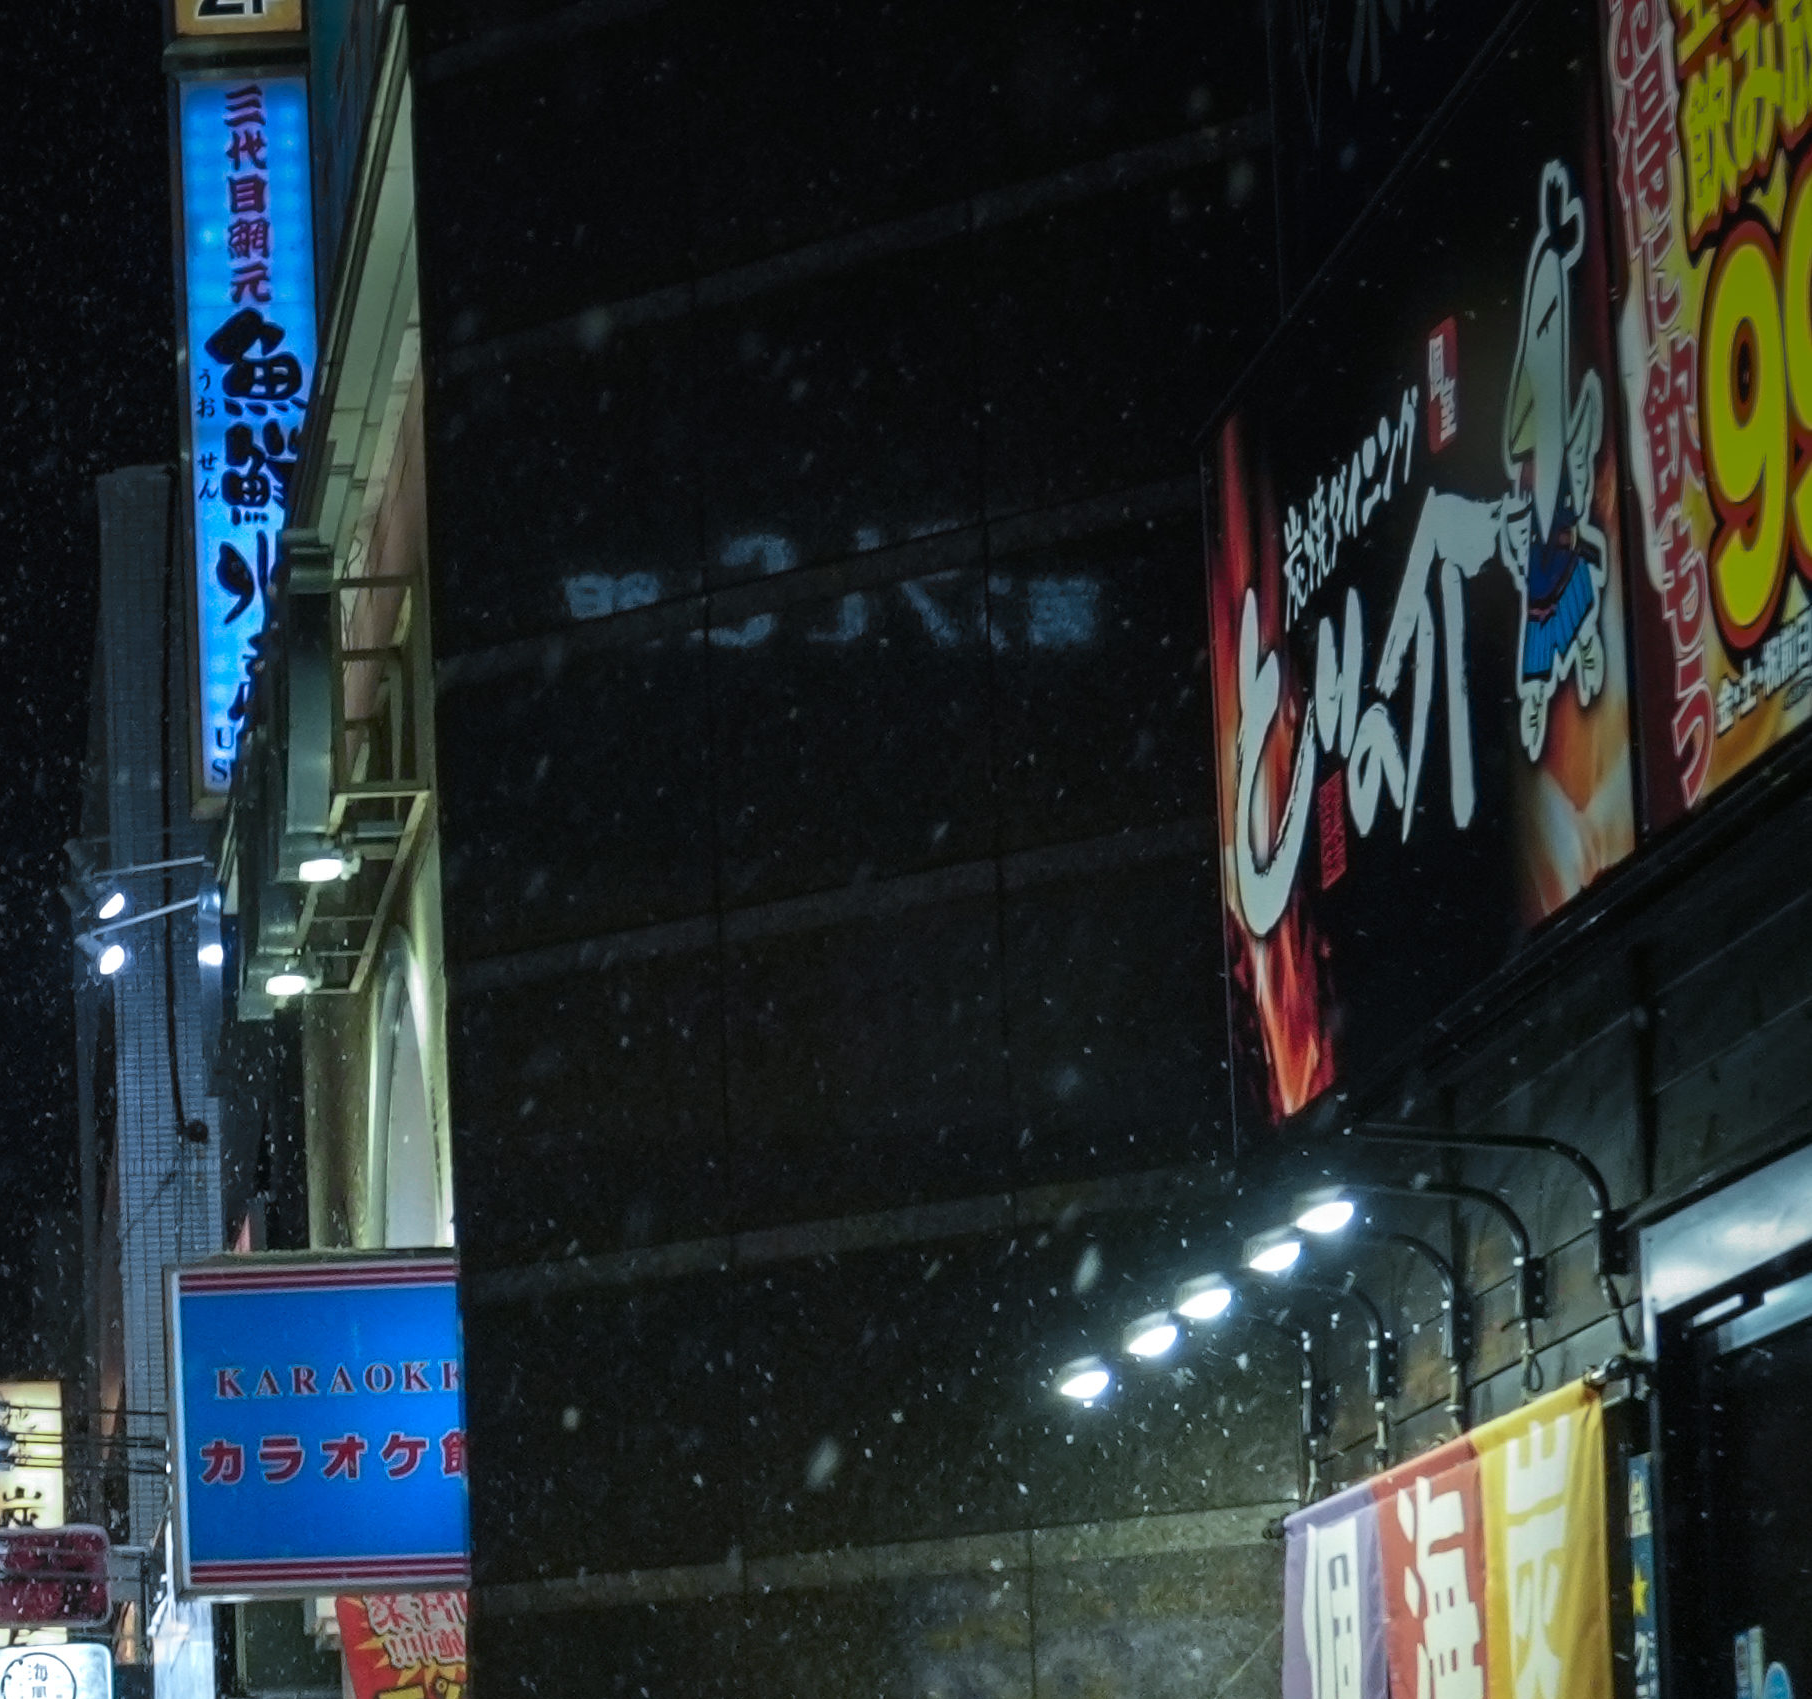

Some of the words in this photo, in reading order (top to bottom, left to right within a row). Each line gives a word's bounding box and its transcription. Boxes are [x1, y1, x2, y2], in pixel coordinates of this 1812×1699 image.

[224, 84, 272, 304] 三代目網元
[1283, 384, 1419, 633] 炭焼ダイニング
